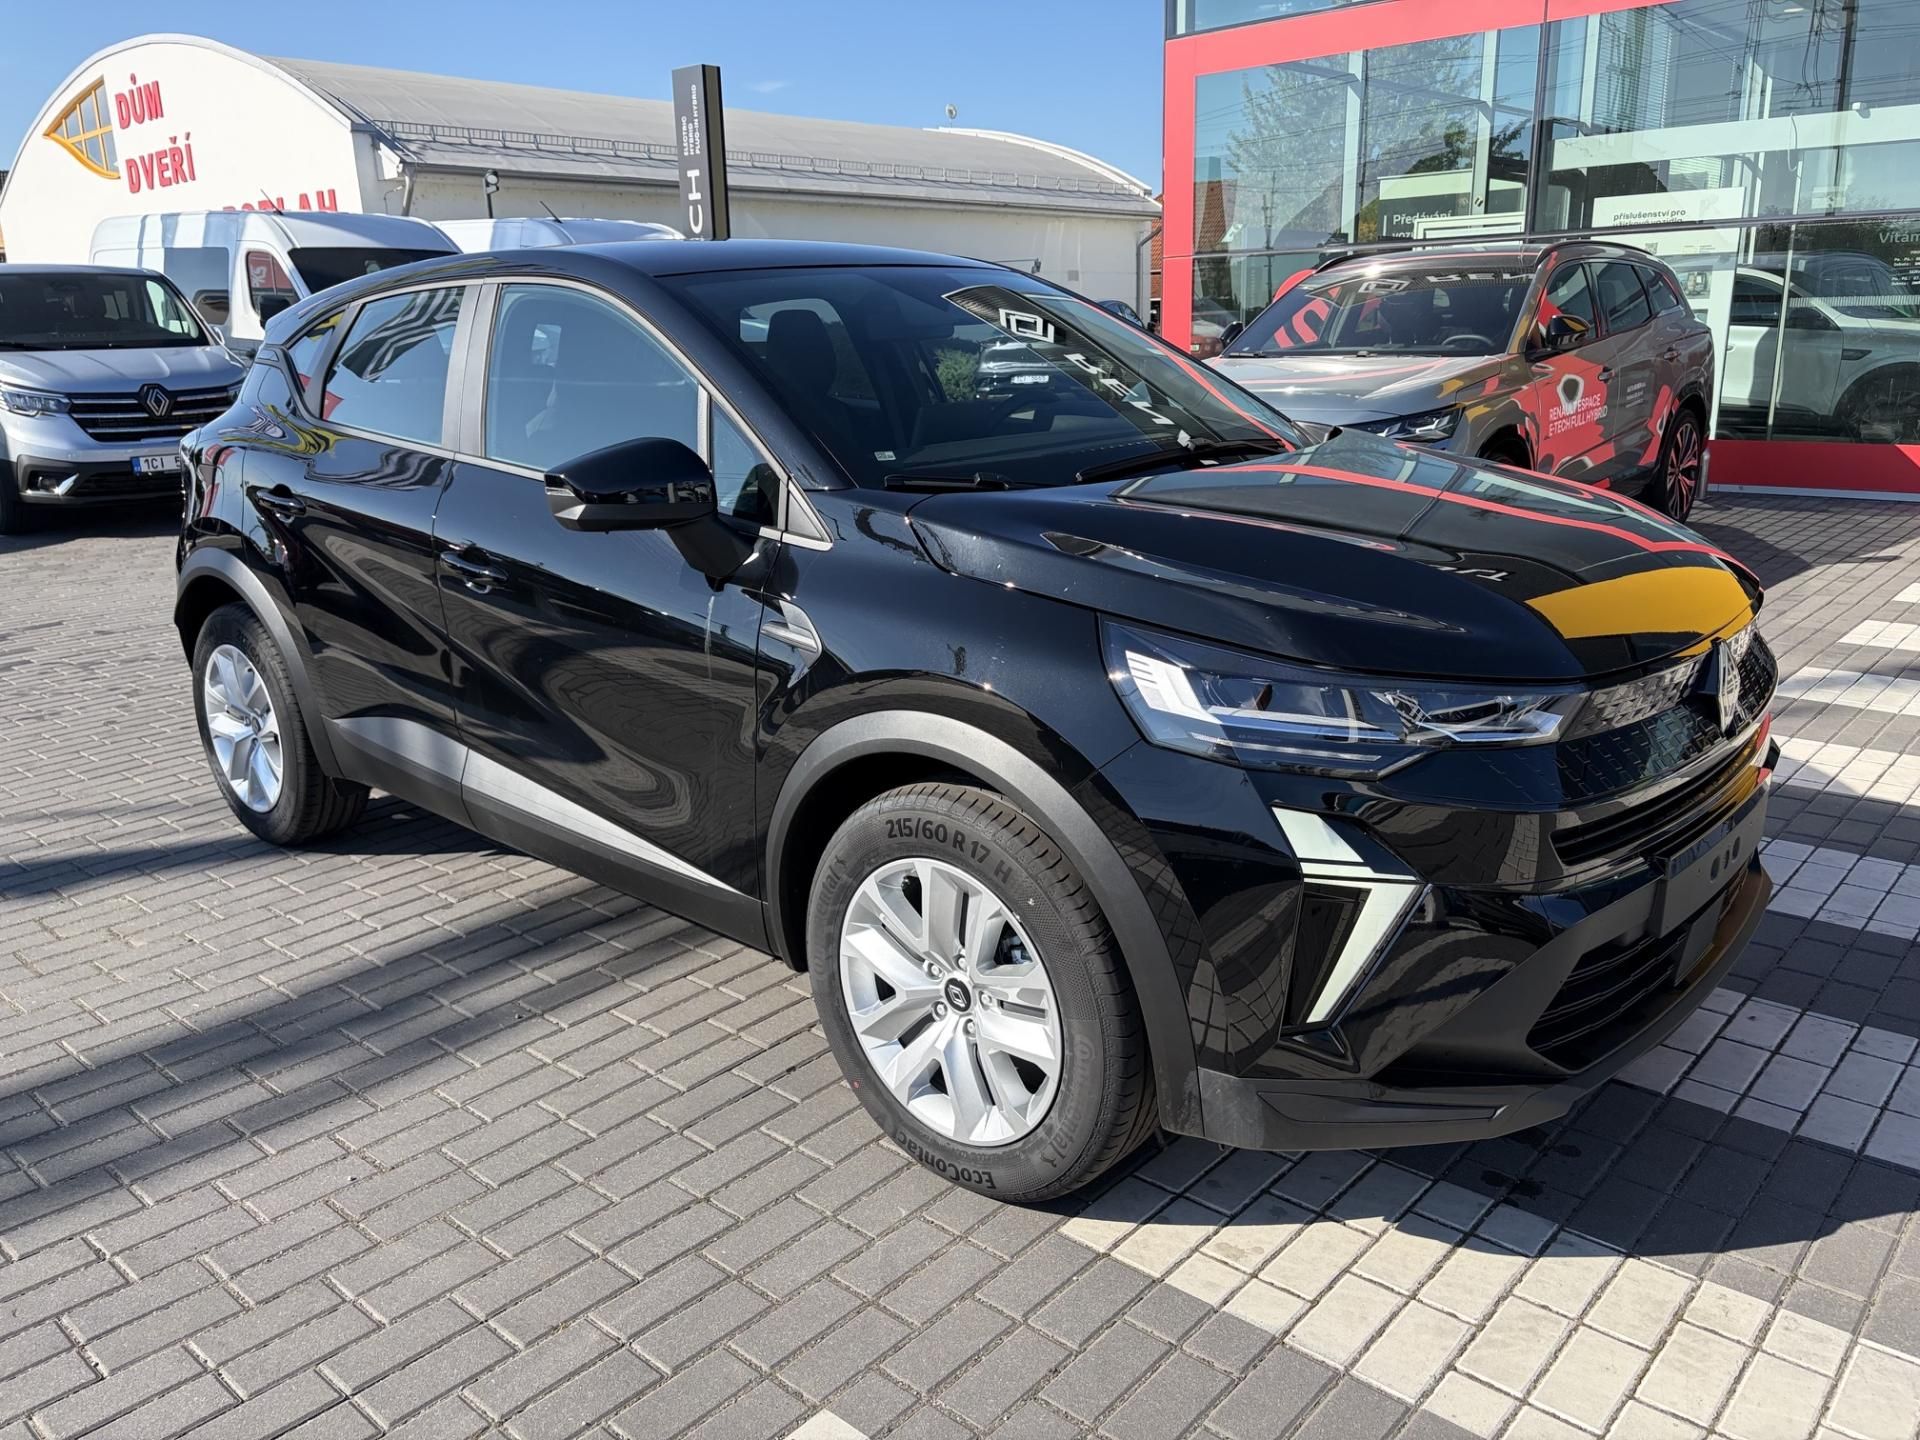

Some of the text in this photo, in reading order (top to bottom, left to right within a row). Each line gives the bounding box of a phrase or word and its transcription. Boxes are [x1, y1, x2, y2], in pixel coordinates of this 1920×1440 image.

[115, 73, 164, 129] DŮM
[681, 116, 689, 156] ELECTRIC
[125, 132, 196, 194] DVEŘÍ
[687, 169, 704, 241] CH
[1670, 209, 1687, 218] pro
[1570, 411, 1586, 428] FULL
[1586, 405, 1608, 423] HYBRID
[1577, 393, 1601, 412] ESPACE
[886, 817, 1013, 884] 215/60 R 17 H
